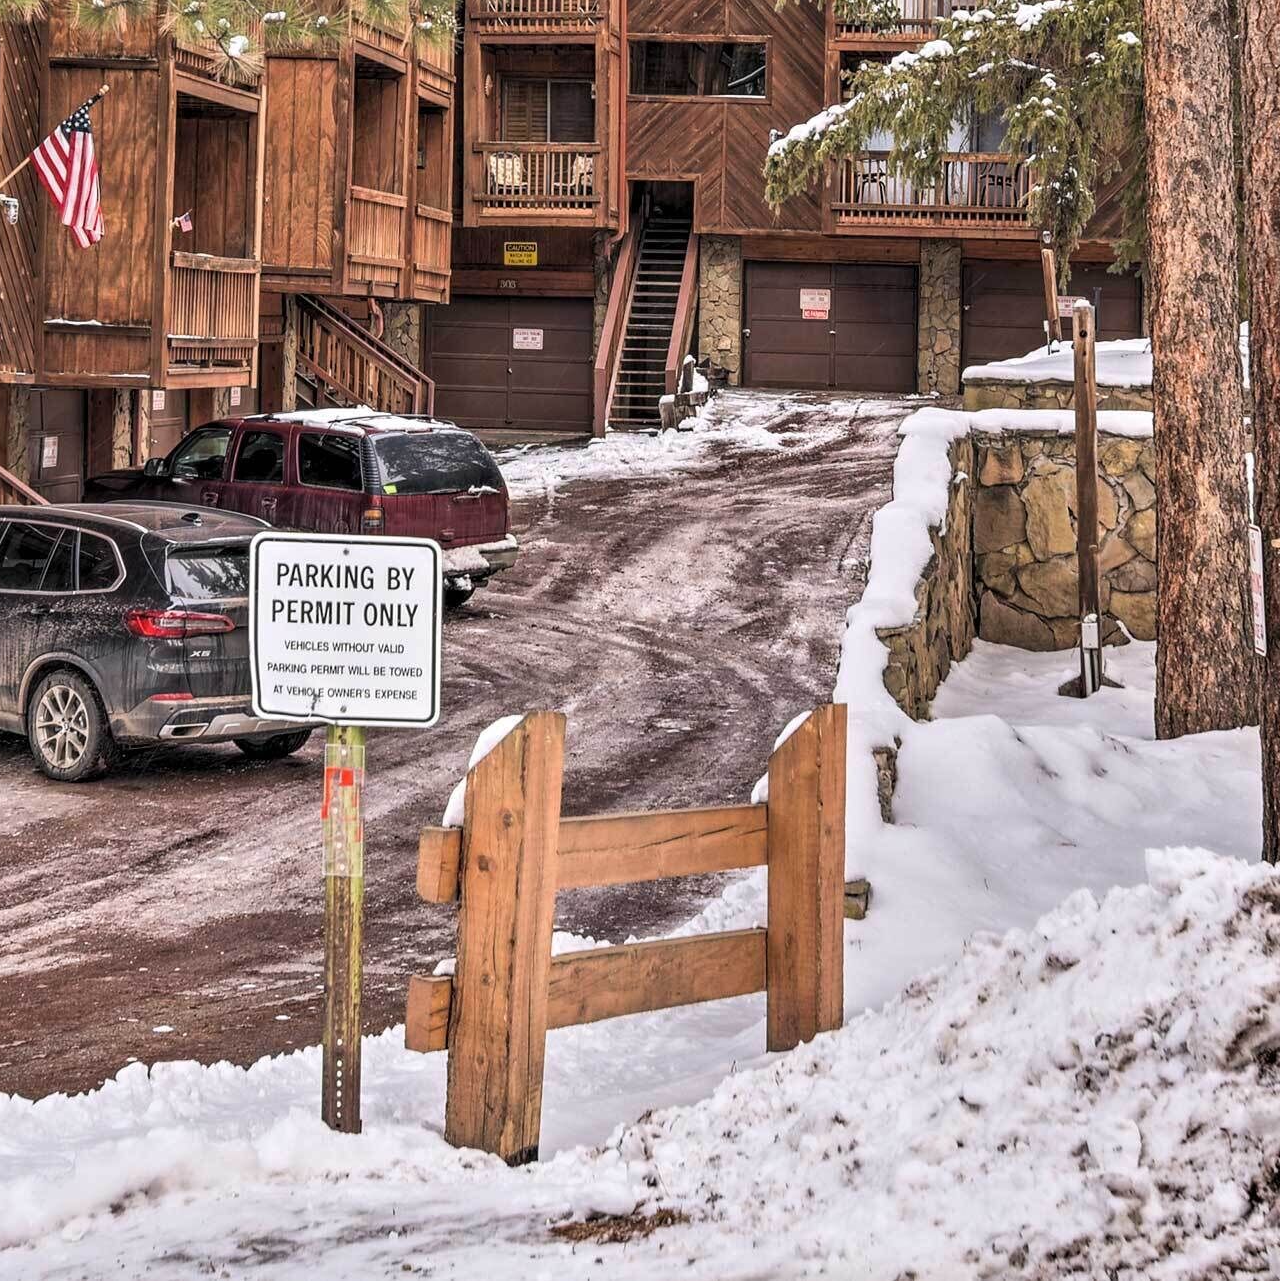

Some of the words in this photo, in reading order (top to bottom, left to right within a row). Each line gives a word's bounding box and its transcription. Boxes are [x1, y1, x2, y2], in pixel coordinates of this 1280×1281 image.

[276, 563, 375, 590] PARKING
[387, 567, 415, 591] BY
[272, 599, 355, 625] PERMIT
[363, 602, 419, 628] ONLY
[284, 640, 329, 651] VEHICLES
[332, 642, 375, 653] WITHOUT
[378, 644, 405, 654] VALID
[267, 662, 307, 674] PARKING
[310, 664, 345, 675] PERMIT
[348, 666, 370, 676] WILL
[373, 667, 386, 676] BE
[389, 667, 423, 677] TOWED
[273, 685, 283, 695] AT
[286, 686, 324, 698] VEHICLE
[327, 687, 371, 698] OWNER'S
[375, 689, 418, 700] EXPENSE
